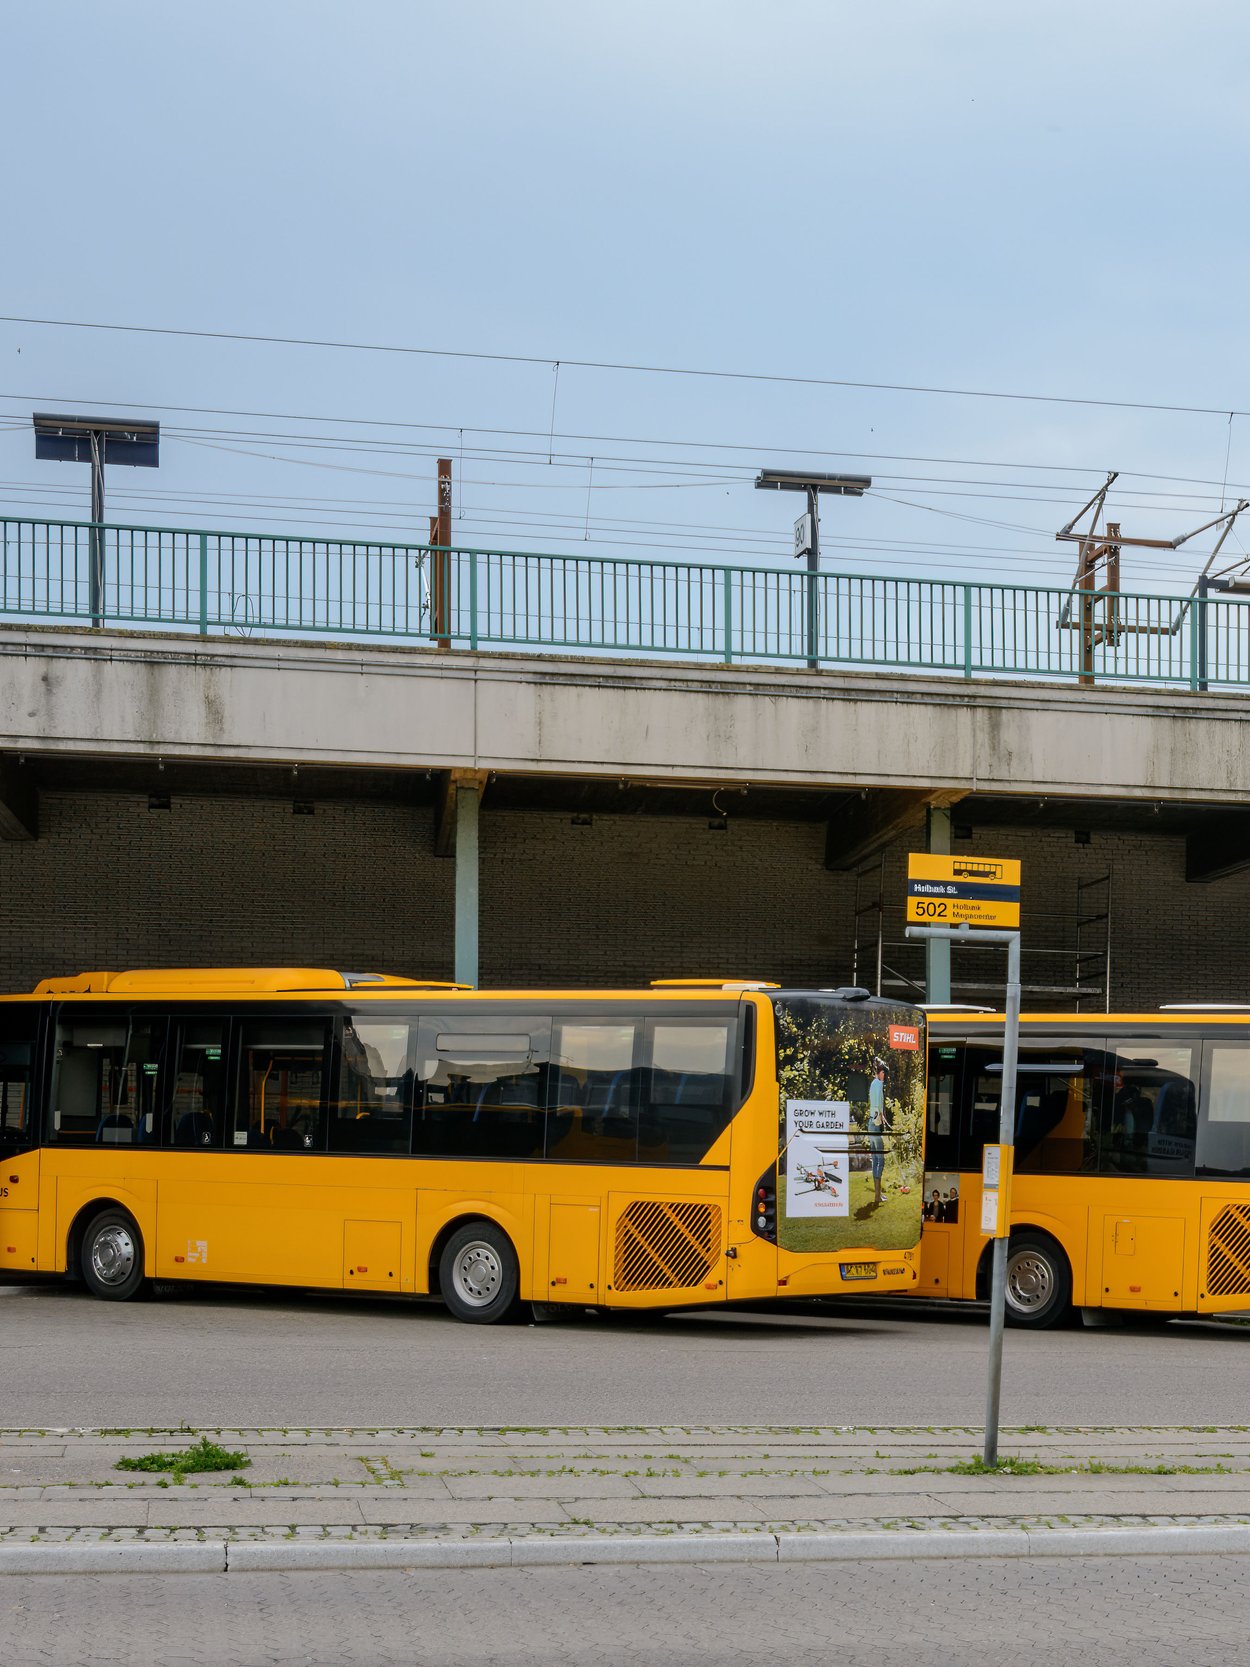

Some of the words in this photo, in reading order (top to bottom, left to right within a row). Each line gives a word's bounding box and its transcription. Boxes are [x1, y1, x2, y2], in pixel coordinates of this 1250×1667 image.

[916, 902, 947, 917] 502
[894, 1032, 916, 1044] STIHL
[816, 1121, 844, 1129] GARDEN
